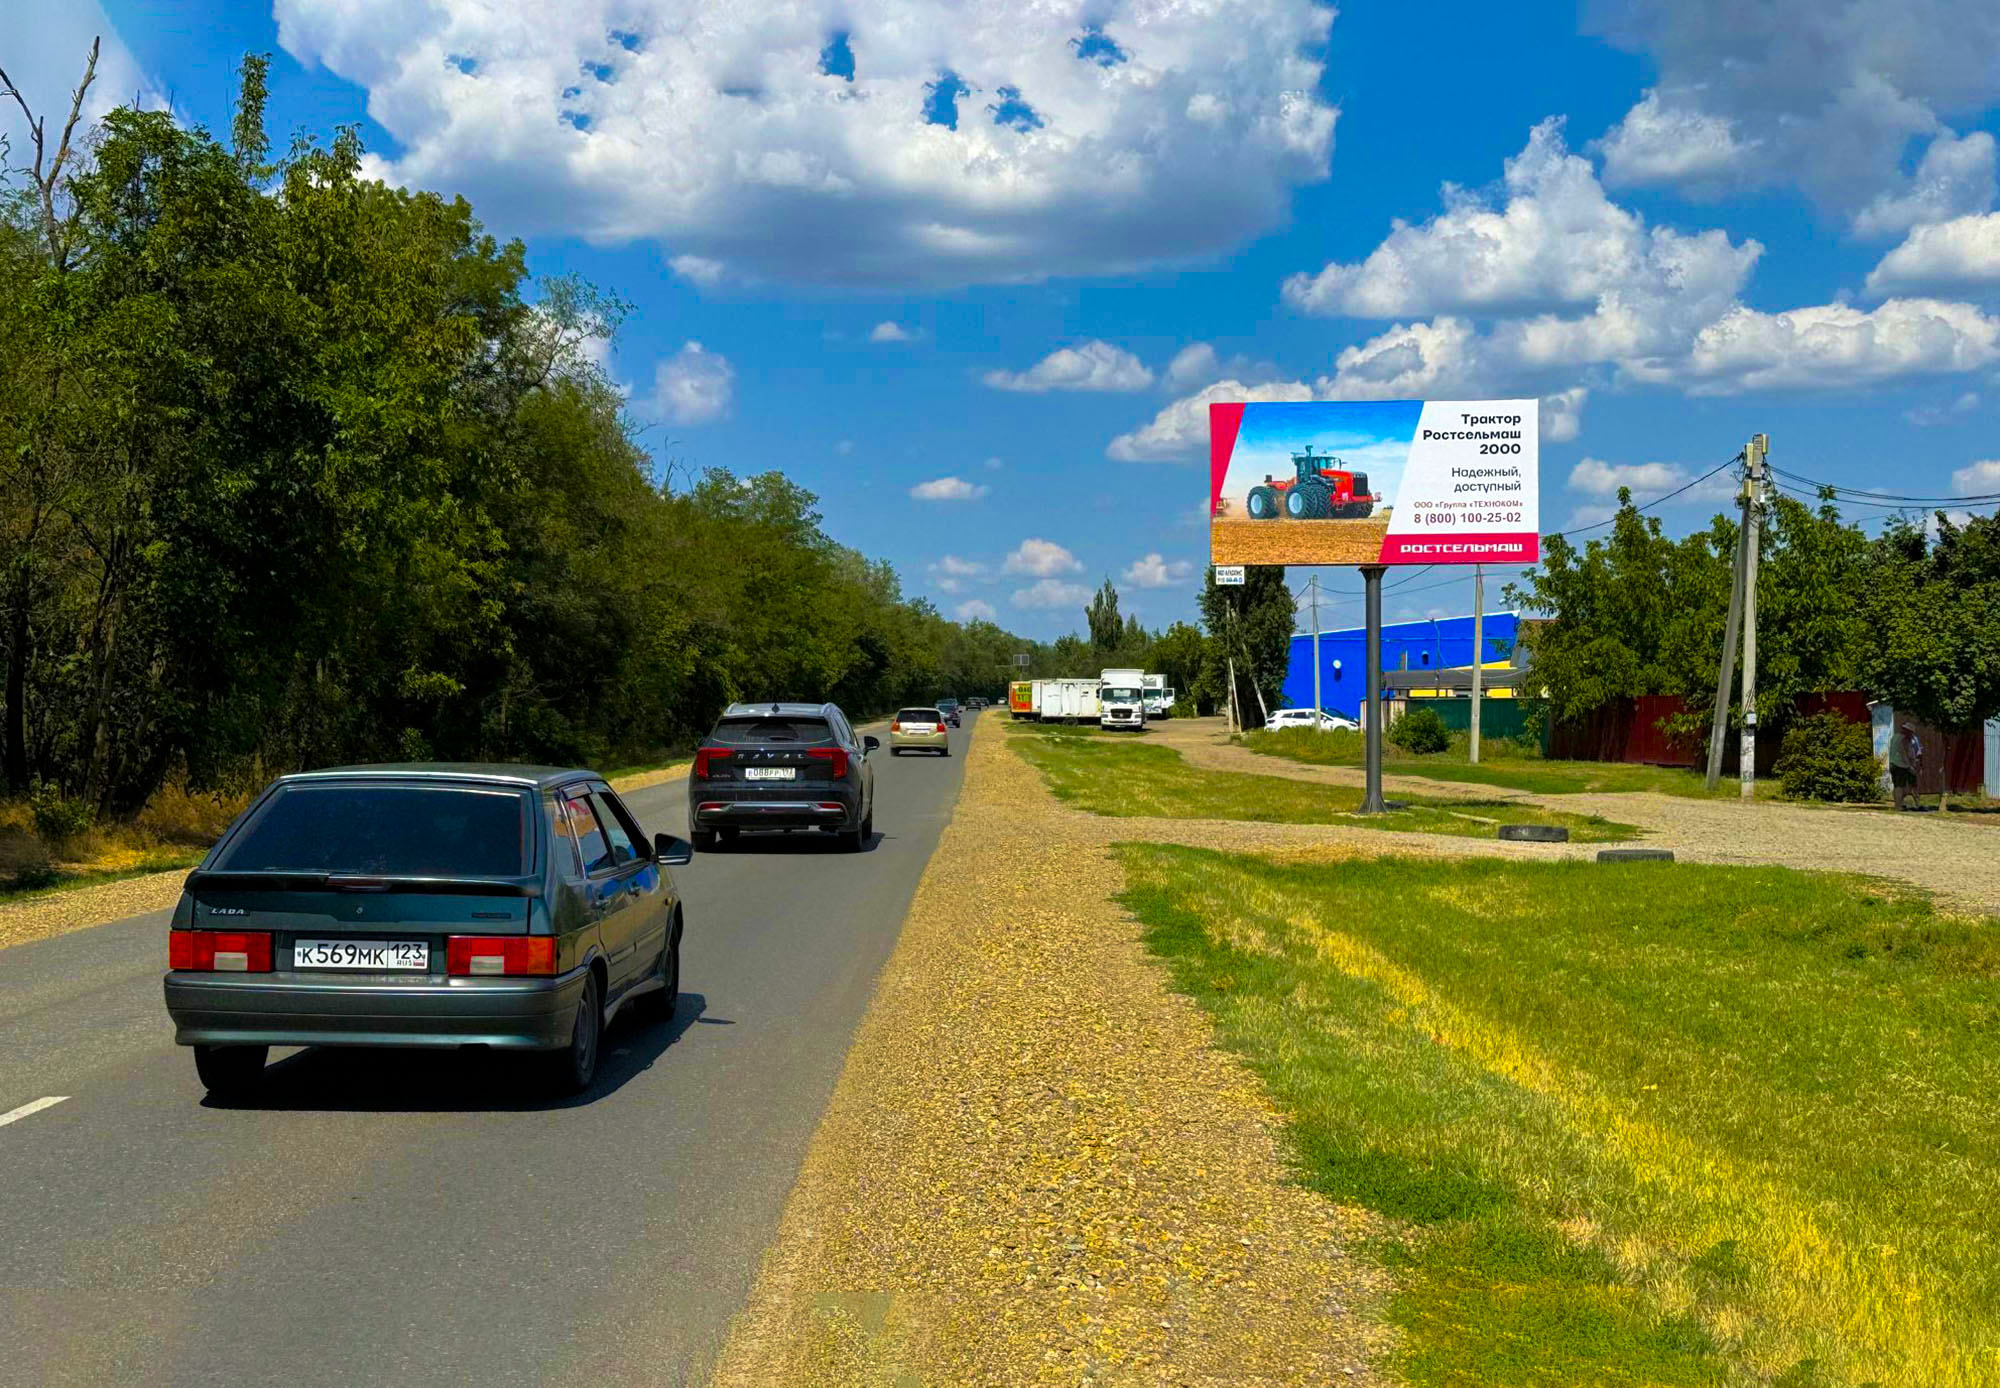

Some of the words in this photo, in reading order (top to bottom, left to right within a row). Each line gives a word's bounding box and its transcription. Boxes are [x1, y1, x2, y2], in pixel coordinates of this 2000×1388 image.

[1461, 413, 1521, 427] Трактор
[1423, 429, 1521, 441] Ростсельмаш
[1479, 443, 1521, 455] 2000
[1451, 466, 1522, 479] Надежный,
[1454, 481, 1522, 494] доступный
[1413, 501, 1433, 509] ООО
[1413, 513, 1421, 524] 8
[1425, 512, 1456, 526] (800)
[1460, 512, 1522, 523] 100-25-02
[1400, 543, 1523, 553] РОСТСЕЛЬМАШ
[302, 943, 385, 965] К569МК
[391, 944, 423, 960] 123
